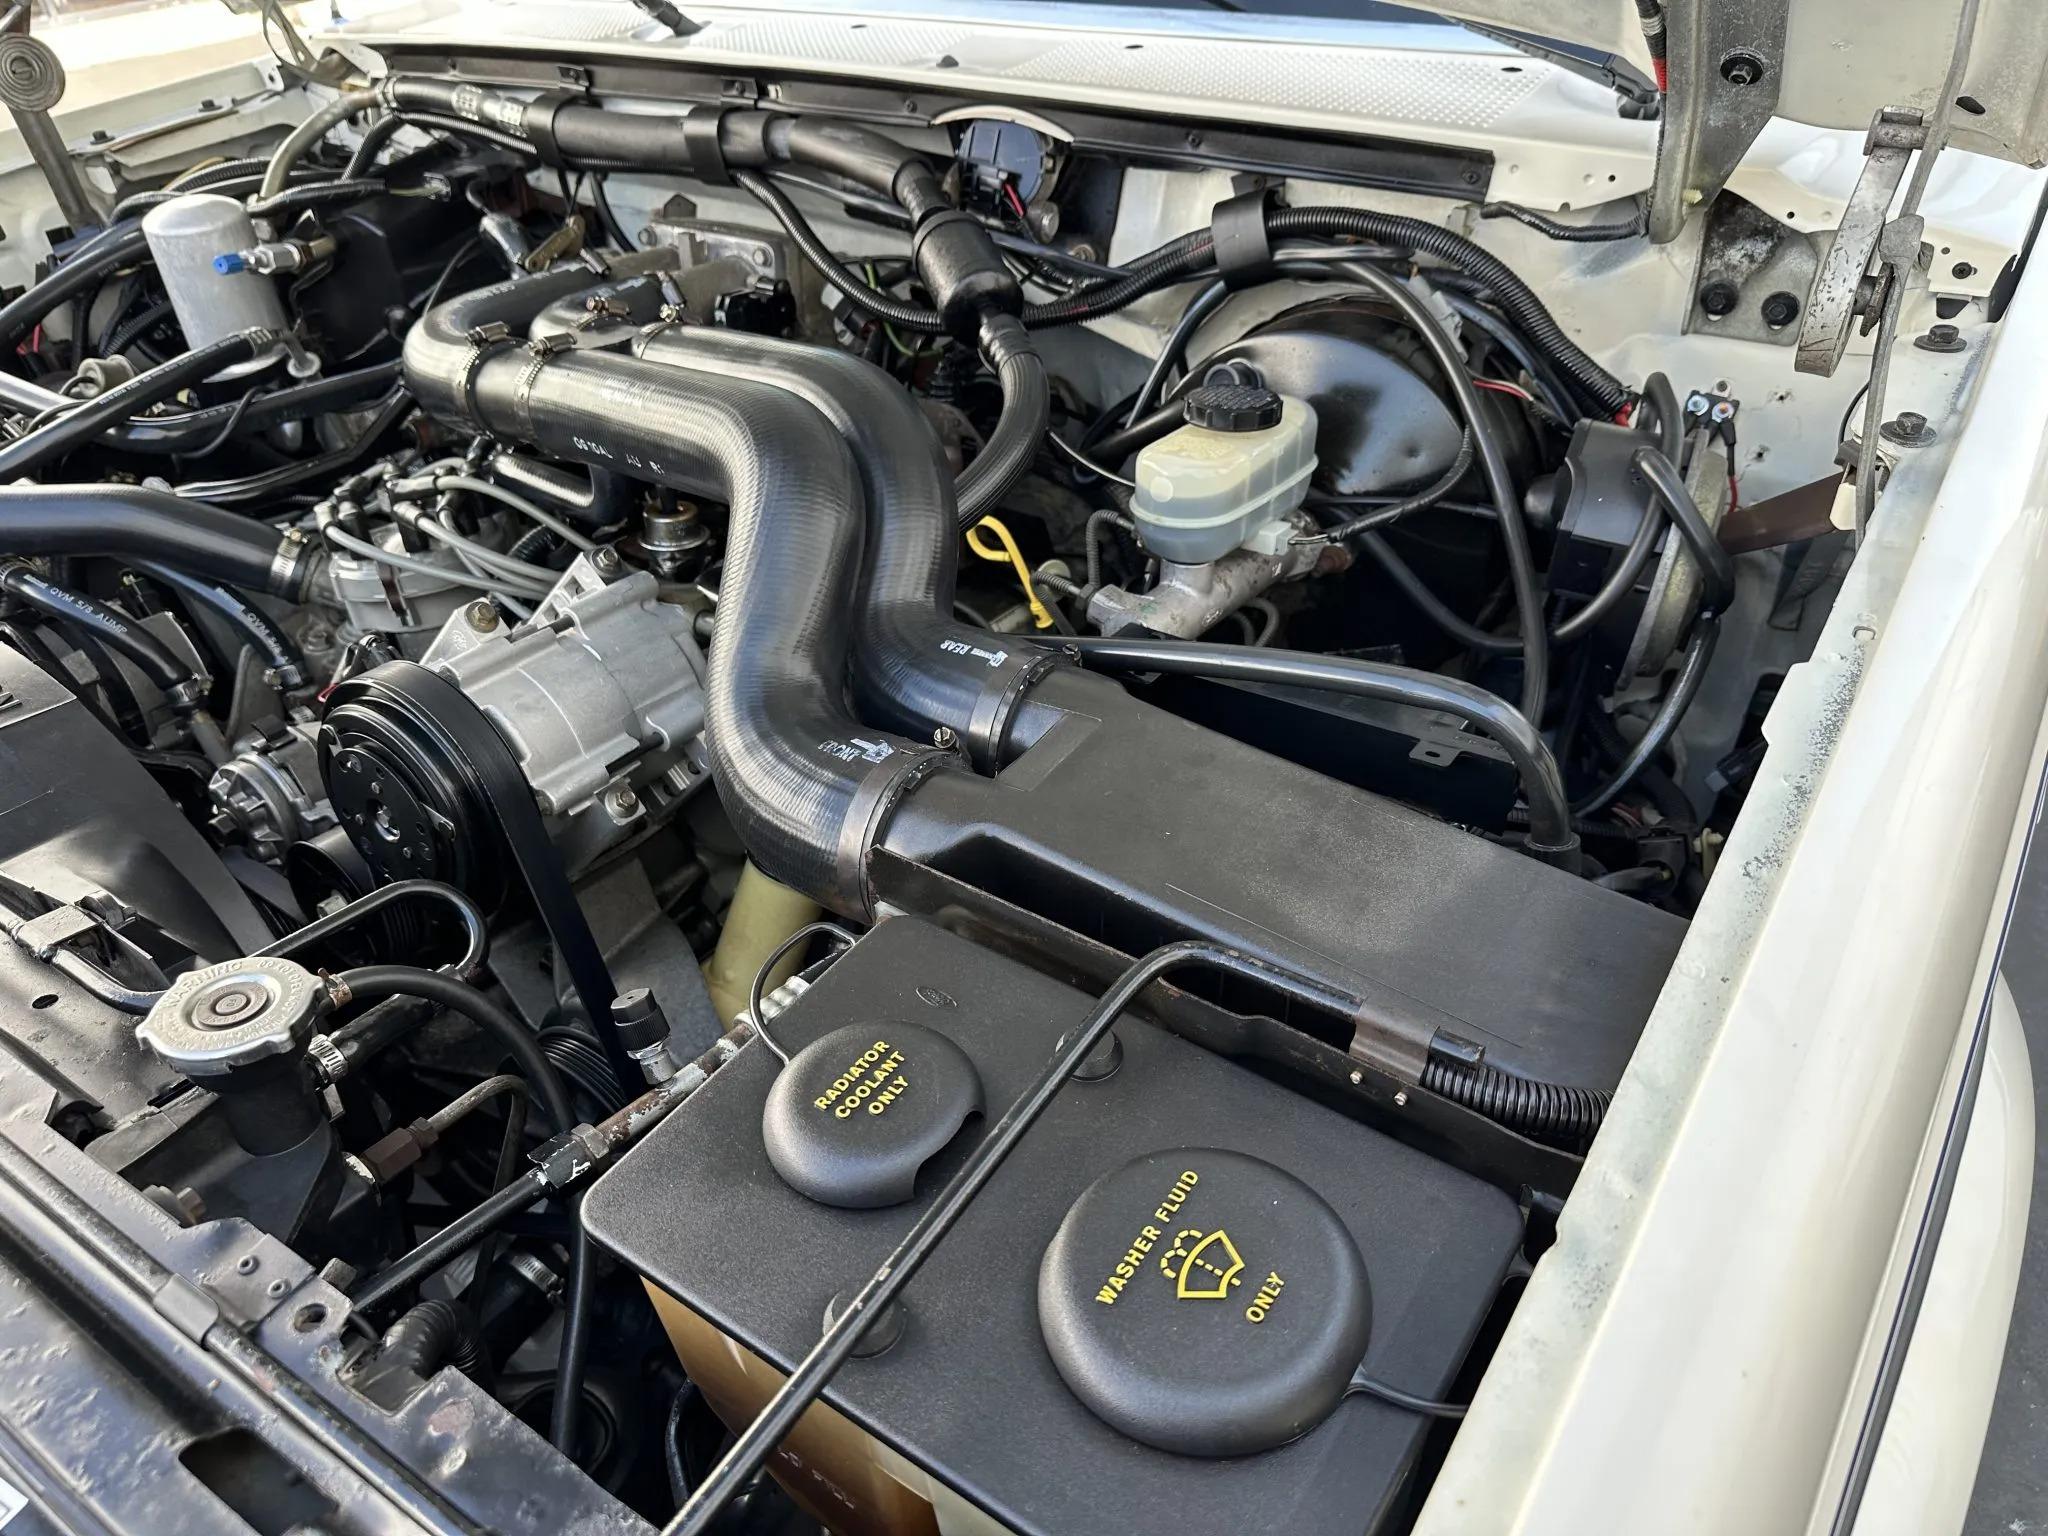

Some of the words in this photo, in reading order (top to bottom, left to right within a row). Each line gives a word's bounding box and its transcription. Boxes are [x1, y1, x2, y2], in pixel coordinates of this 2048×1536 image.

[49, 586, 75, 604] QVM
[75, 599, 94, 614] 5/8
[940, 639, 972, 655] REAR
[813, 1040, 890, 1111] RADIATOR
[834, 1050, 905, 1119] COOLANT
[867, 1075, 909, 1116] ONLY
[1095, 1224, 1162, 1306] WASHER
[1154, 1169, 1199, 1223] FLUID
[1245, 1270, 1285, 1324] ONLY
